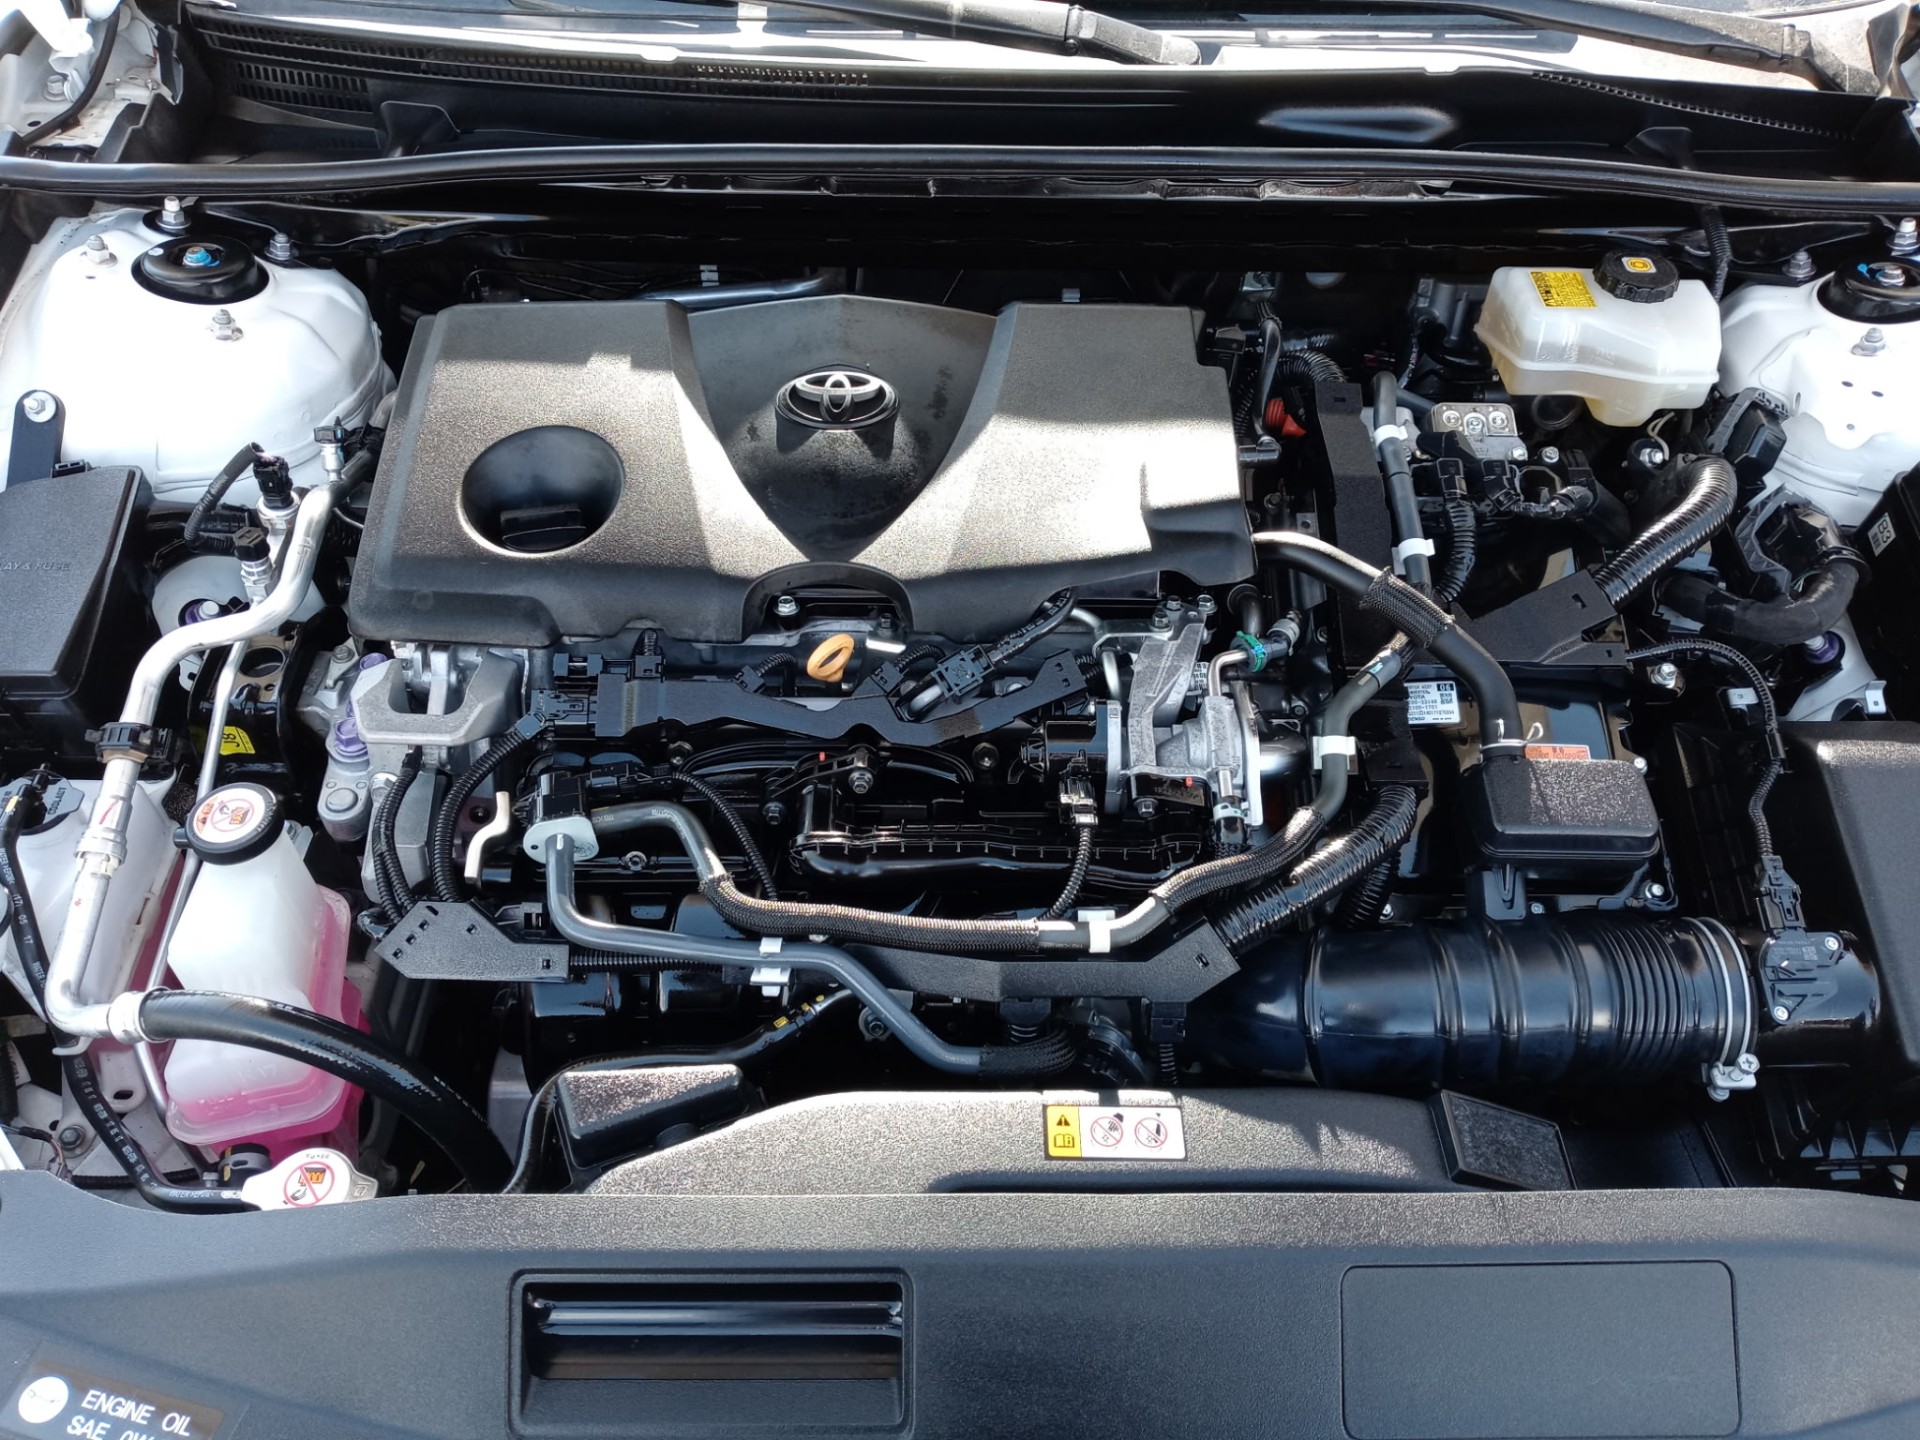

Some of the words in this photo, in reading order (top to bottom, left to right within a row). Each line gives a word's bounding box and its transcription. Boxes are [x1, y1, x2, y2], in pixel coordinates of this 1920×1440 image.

[1878, 519, 1891, 543] B3
[18, 914, 28, 925] 05
[23, 935, 34, 945] 17
[81, 1389, 156, 1425] ENGINE
[161, 1412, 191, 1437] OIL
[66, 1415, 111, 1440] SAE
